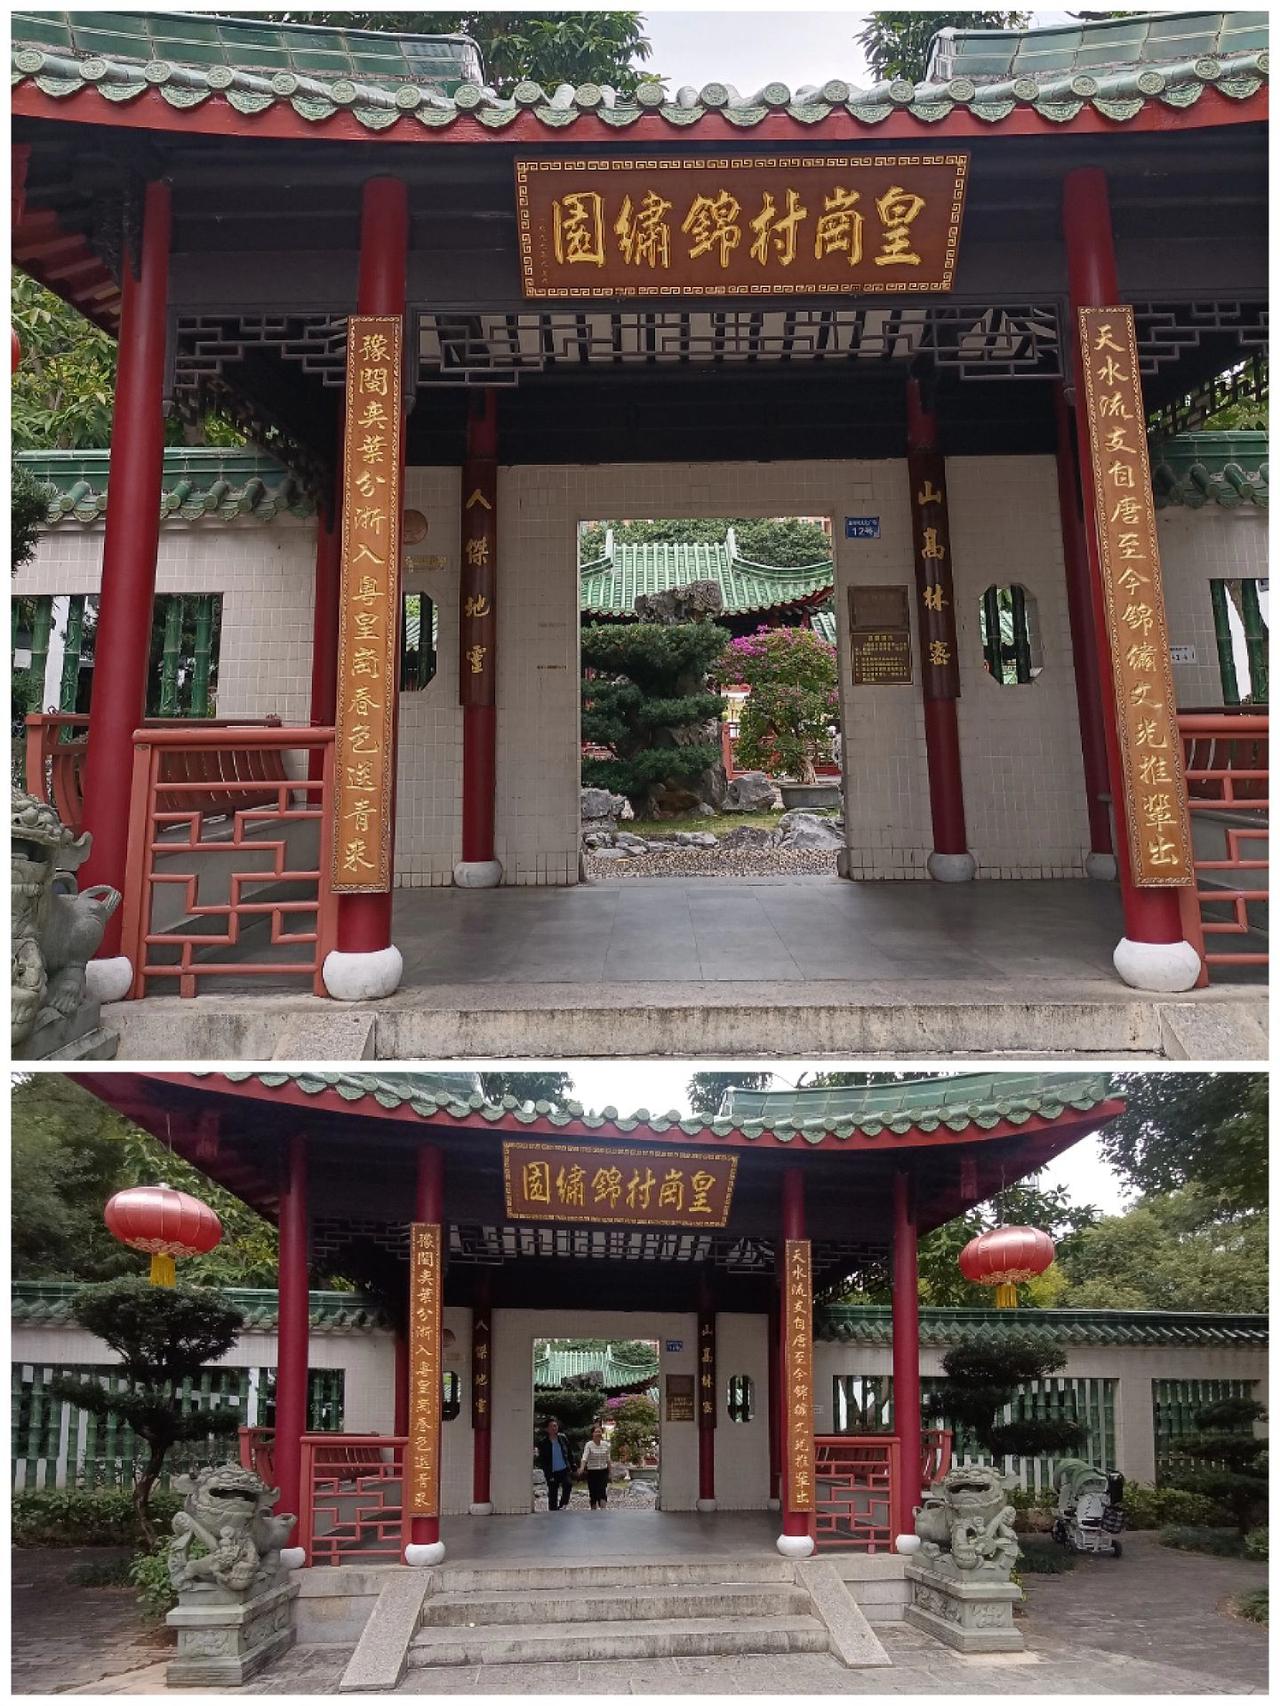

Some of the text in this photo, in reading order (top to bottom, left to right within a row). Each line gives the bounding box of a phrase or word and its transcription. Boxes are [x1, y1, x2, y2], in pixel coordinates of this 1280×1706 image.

[552, 186, 926, 269] 皇崗村錦繡園
[522, 1161, 716, 1214] 皇崗村錦繡園
